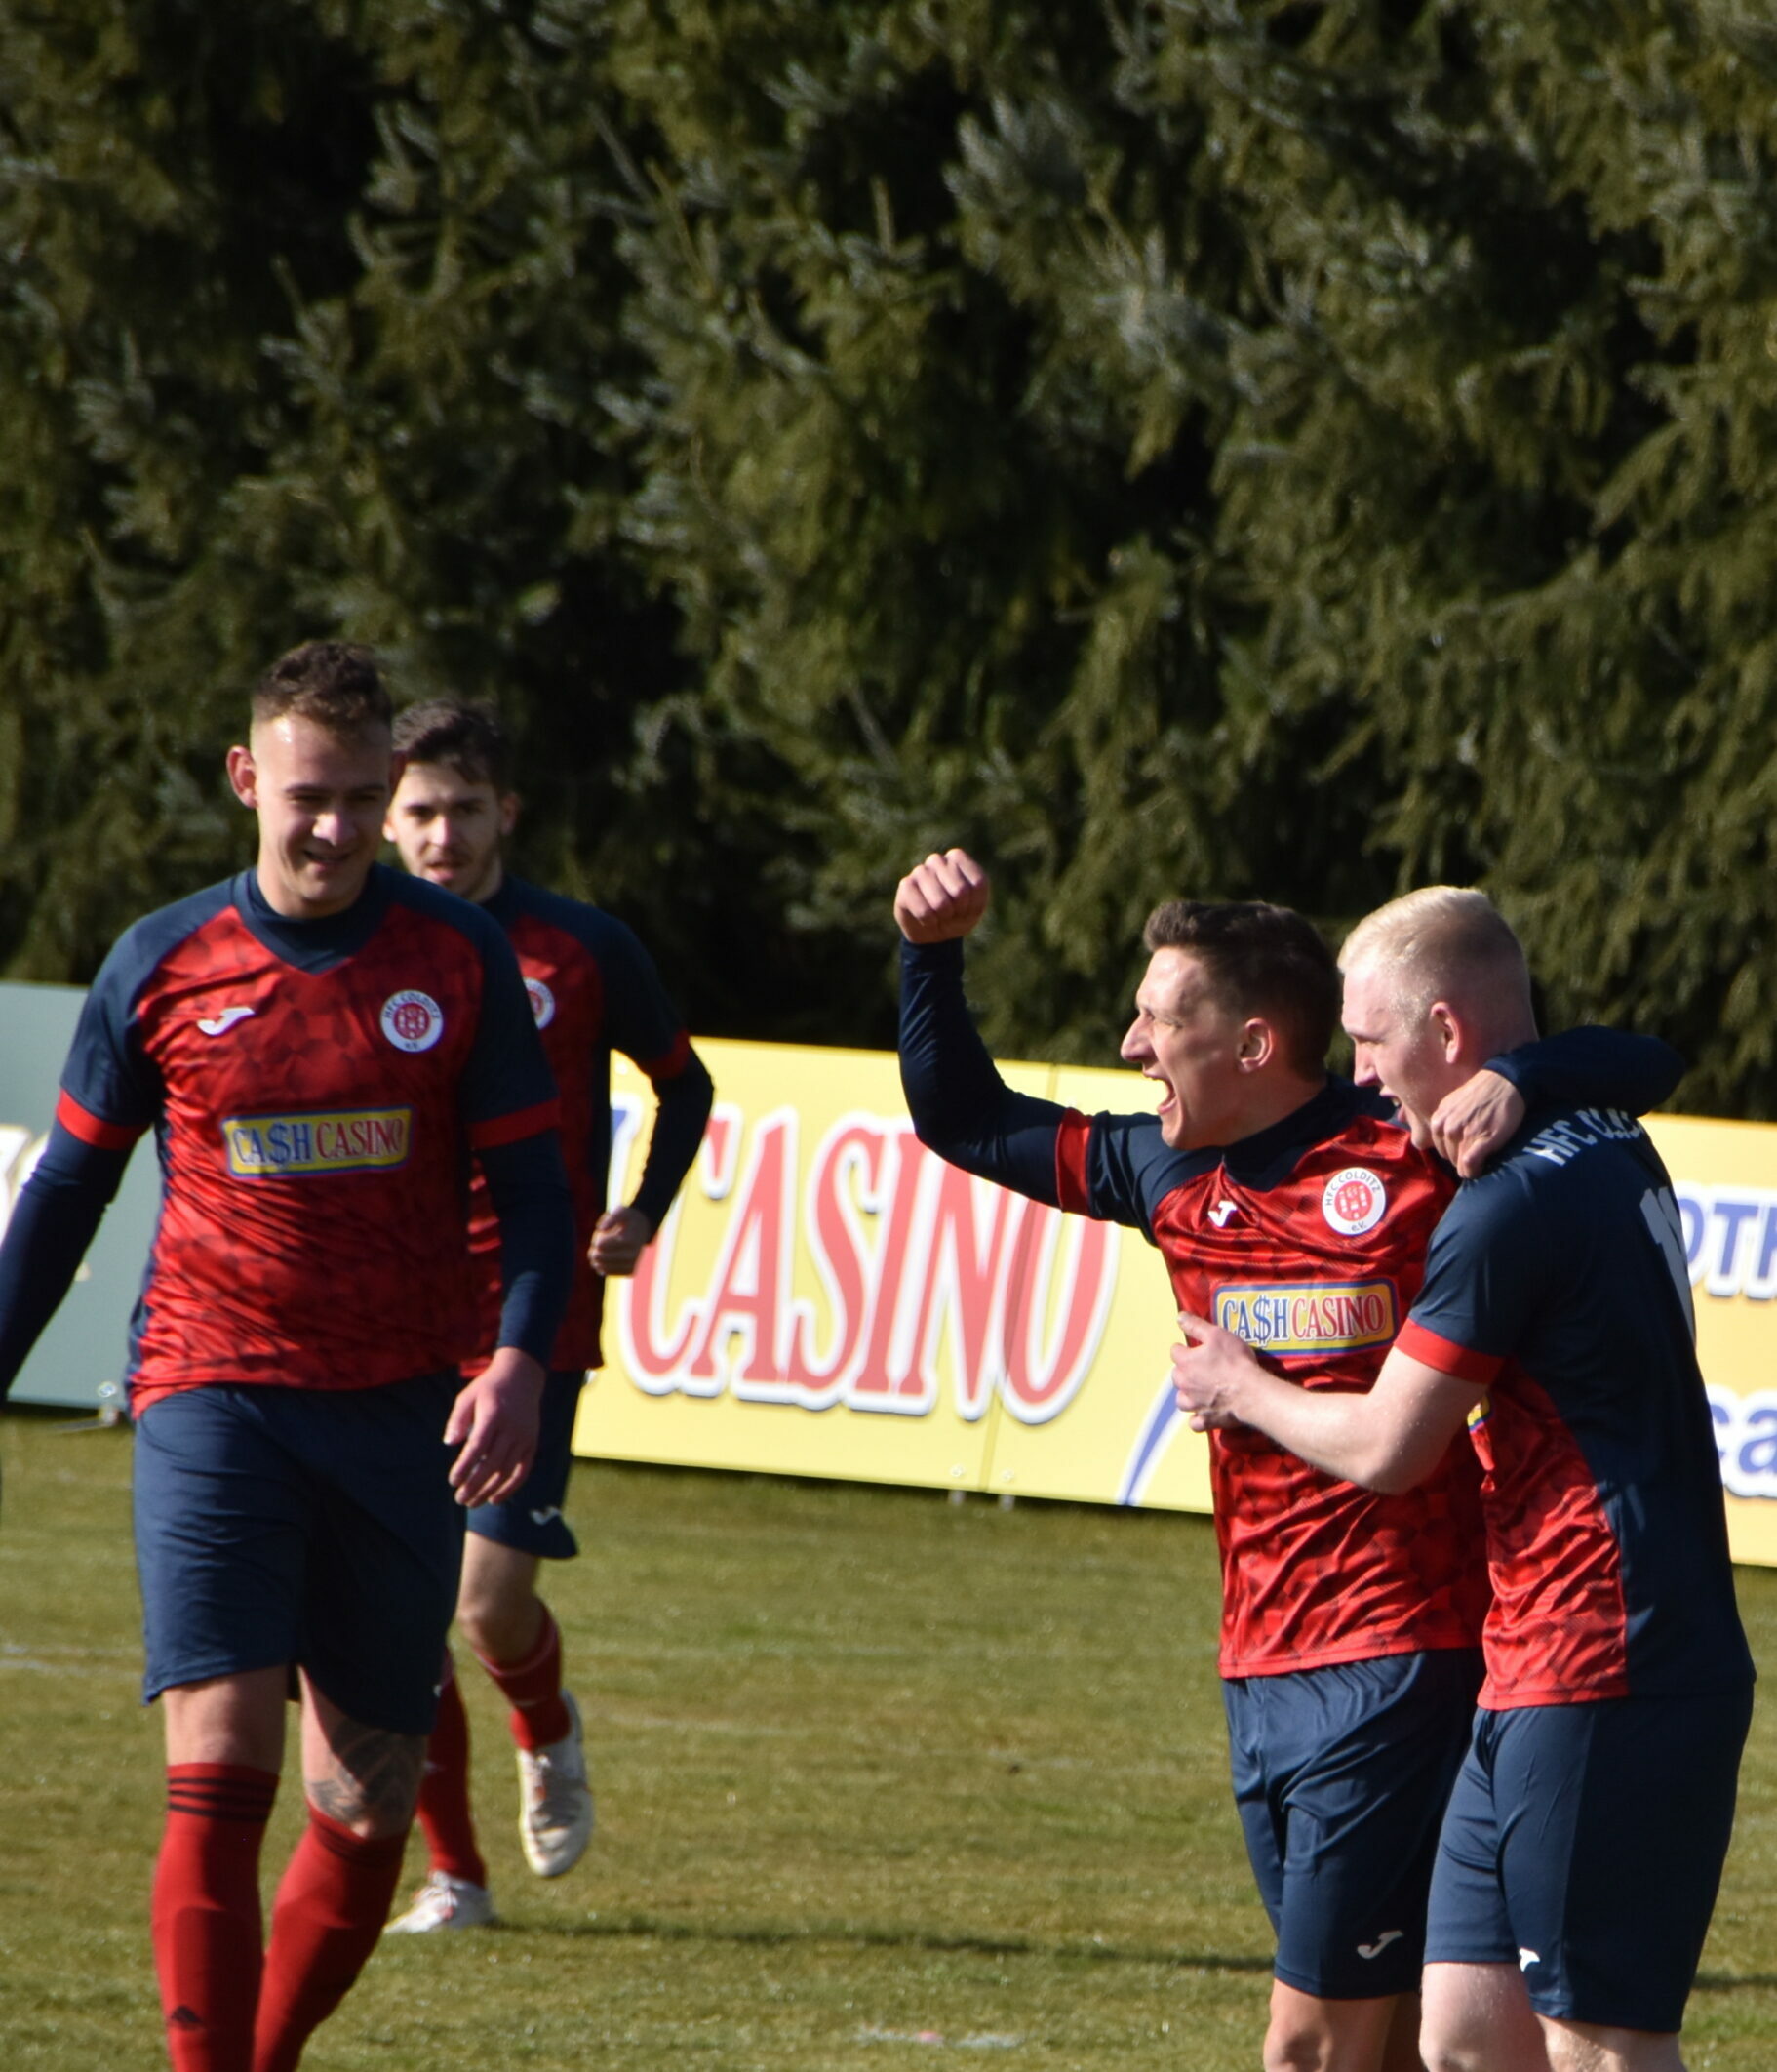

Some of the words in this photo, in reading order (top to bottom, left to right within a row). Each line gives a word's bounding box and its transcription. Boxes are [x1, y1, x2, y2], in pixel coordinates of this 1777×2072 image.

[232, 1121, 312, 1165] CA$H
[315, 1118, 404, 1159] CASINO
[1522, 1120, 1598, 1167] HFC
[1325, 1182, 1339, 1207] HFC
[1338, 1171, 1382, 1193] COLDITZ
[629, 1116, 1110, 1408] CASINO
[1222, 1295, 1288, 1345] CA$H
[1292, 1294, 1385, 1339] CASINO
